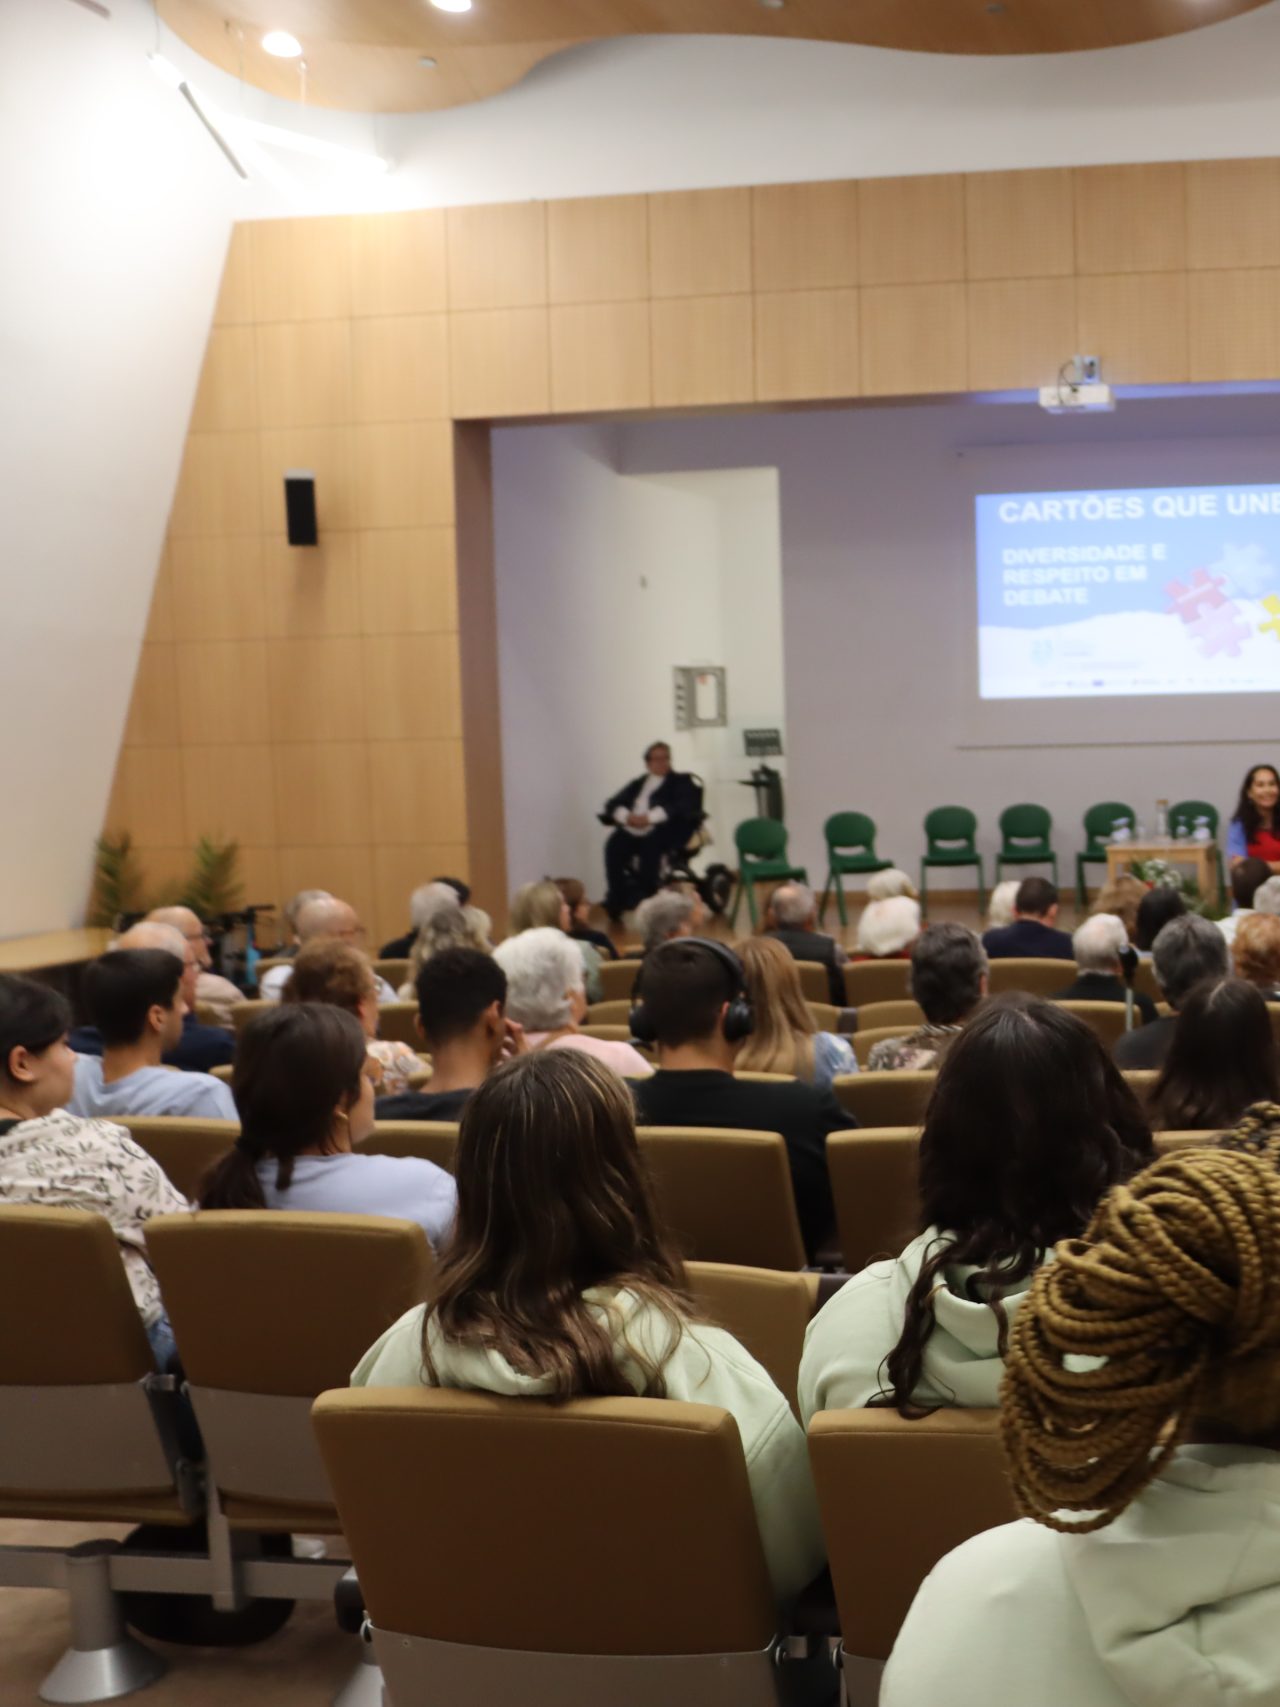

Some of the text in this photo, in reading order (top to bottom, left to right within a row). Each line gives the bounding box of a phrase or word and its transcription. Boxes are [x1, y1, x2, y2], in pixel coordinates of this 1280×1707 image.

[999, 494, 1144, 523] CARTÕES
[1152, 493, 1217, 518] QUE
[1003, 543, 1166, 565] DIVERSIDADE E
[1003, 565, 1147, 586] RESPEITO EM
[1003, 587, 1089, 606] DEBATE
